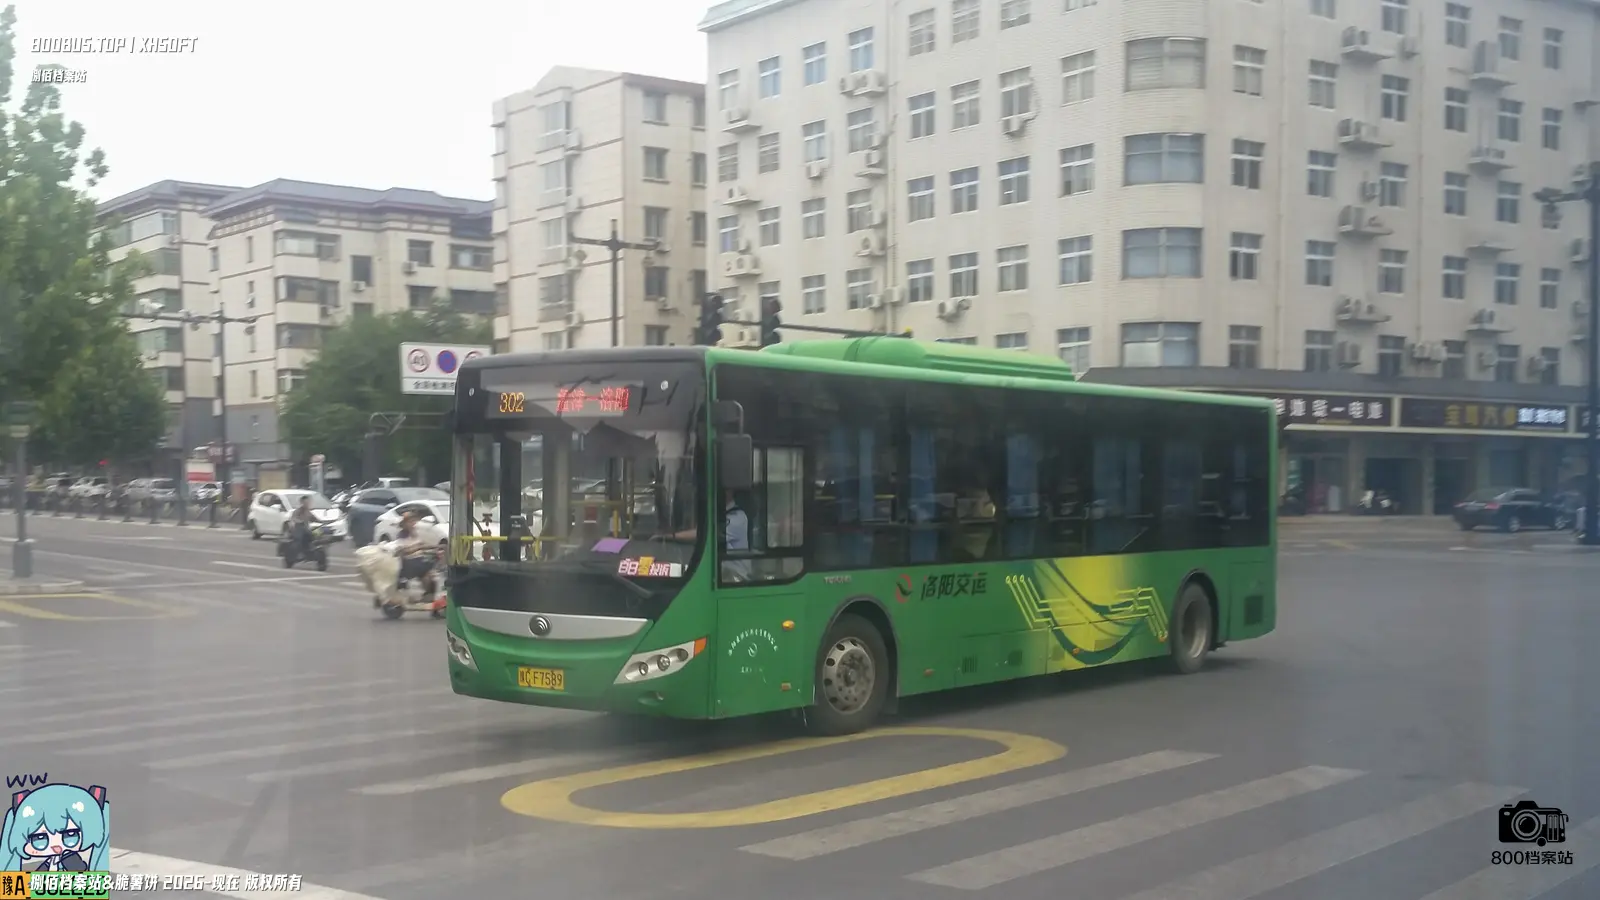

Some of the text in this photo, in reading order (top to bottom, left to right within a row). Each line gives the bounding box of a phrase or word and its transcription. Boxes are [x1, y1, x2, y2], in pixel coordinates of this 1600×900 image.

[500, 391, 525, 412] 302
[920, 572, 988, 601] 洛阳交运
